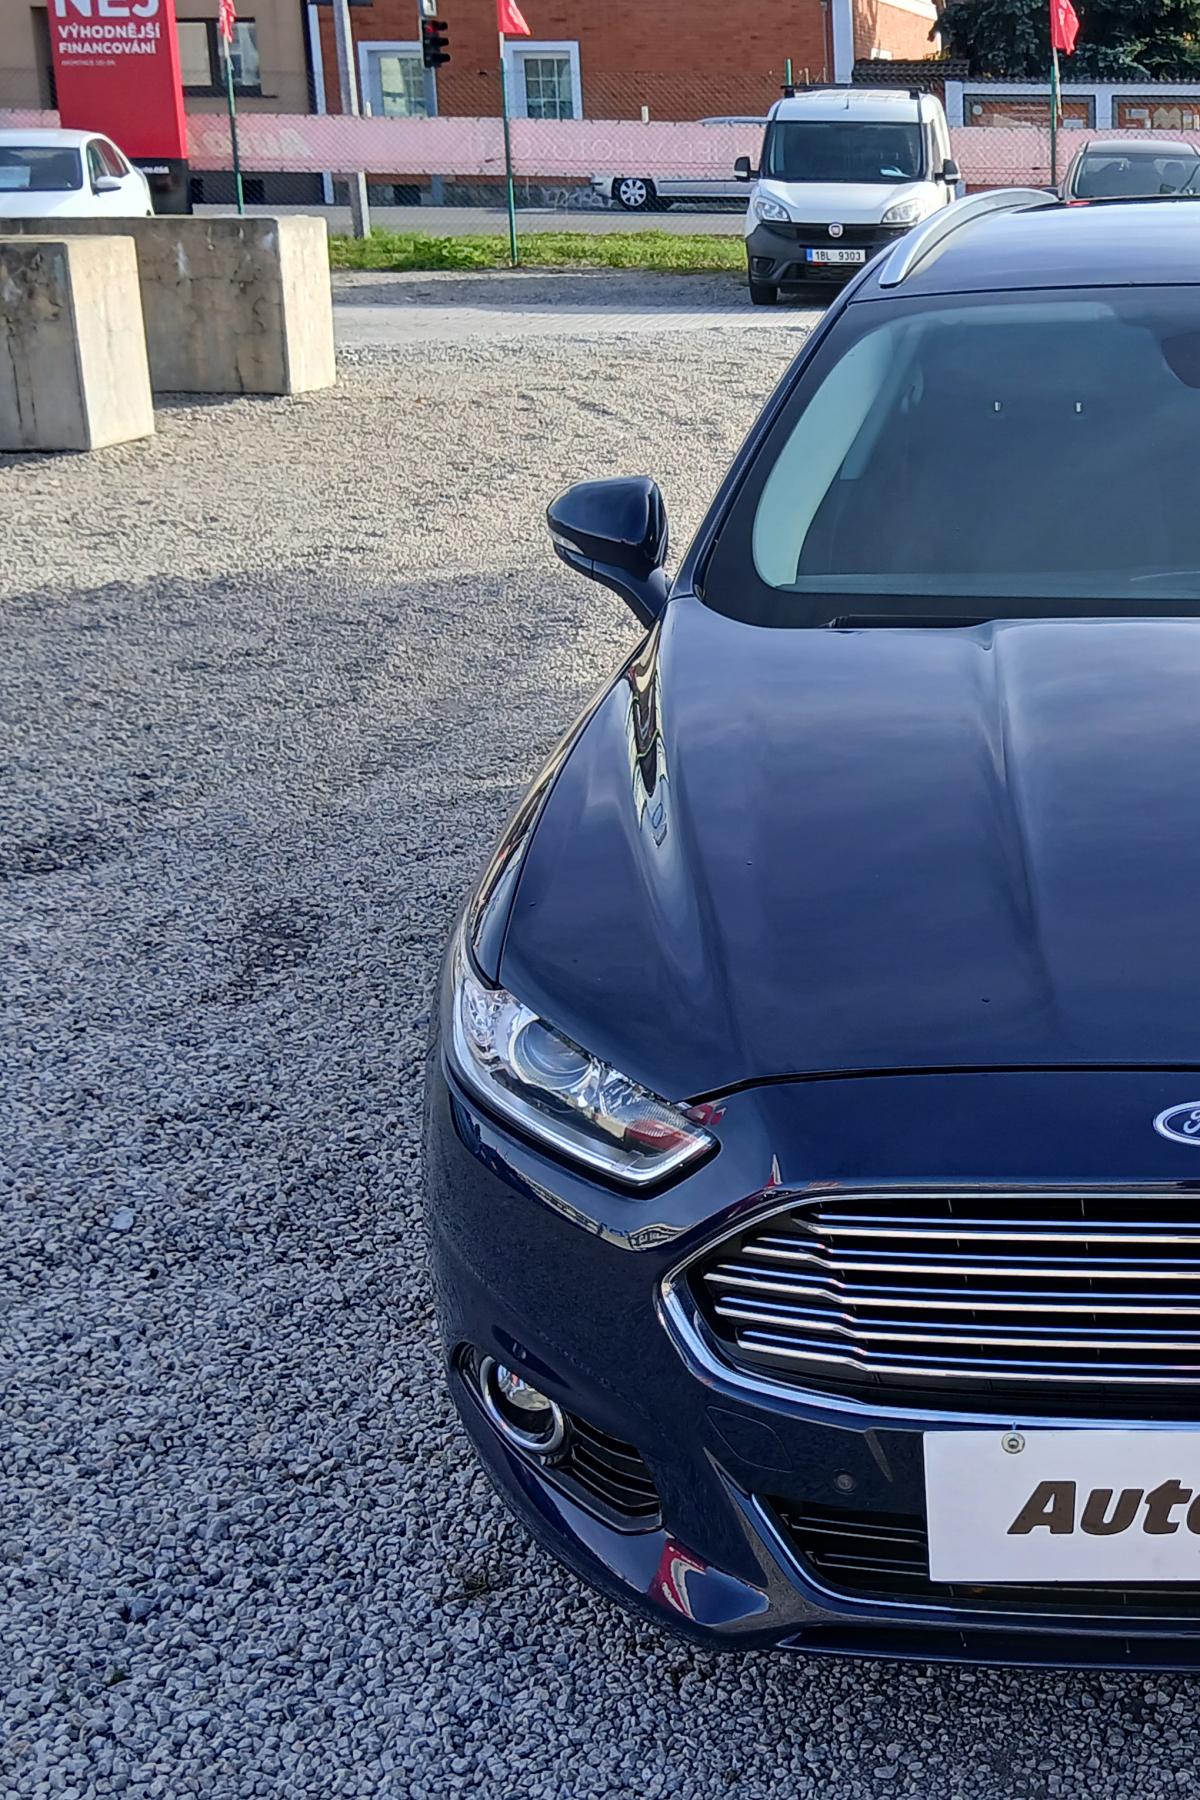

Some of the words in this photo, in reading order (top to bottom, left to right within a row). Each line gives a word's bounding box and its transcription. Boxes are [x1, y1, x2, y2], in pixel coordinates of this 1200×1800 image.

[58, 22, 161, 39] VÝHODNĚJŠÍ
[59, 40, 156, 54] FINANCOVÁNÍ
[815, 251, 832, 261] 1BL
[838, 251, 861, 261] 9303
